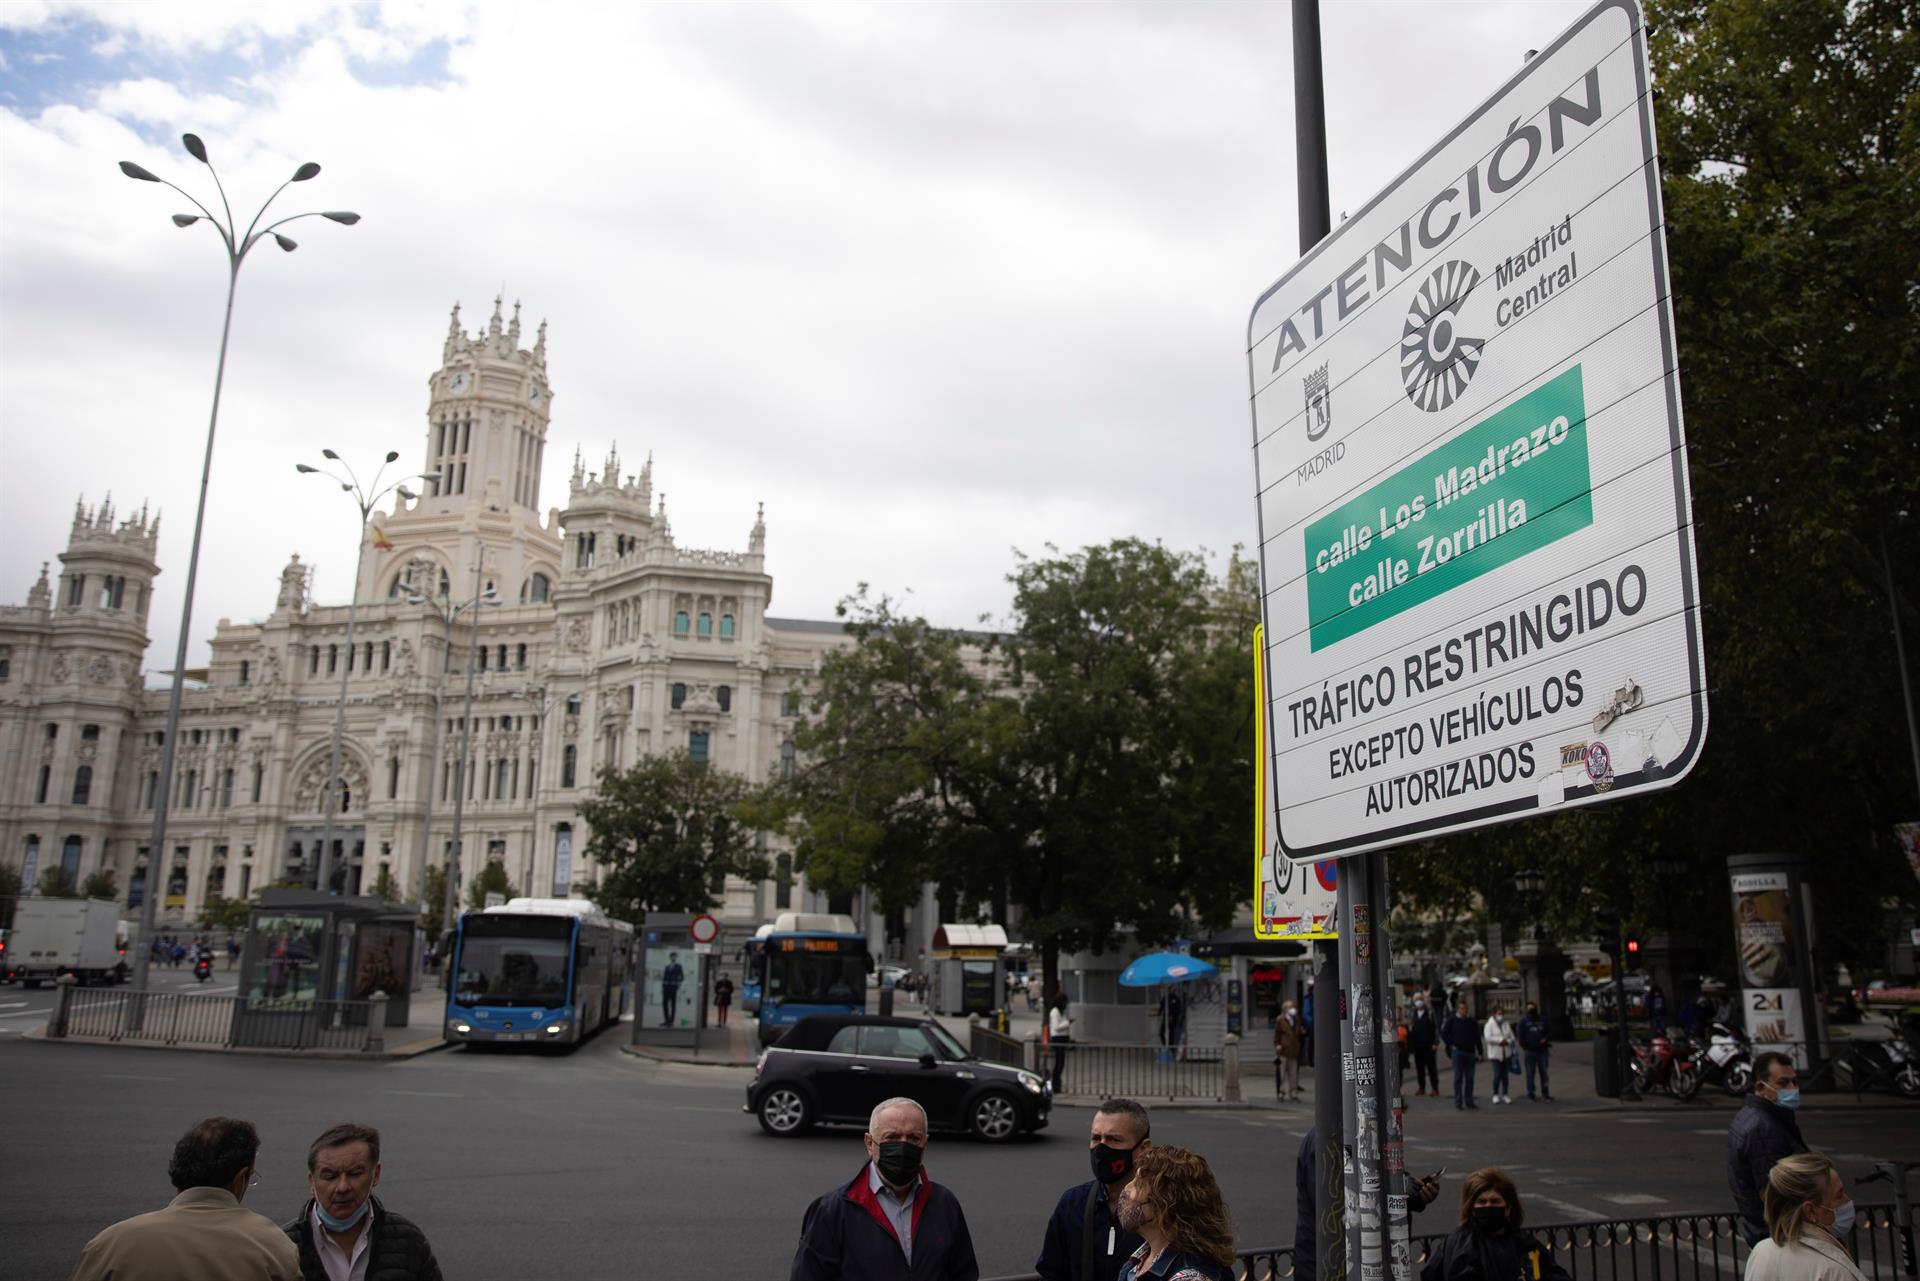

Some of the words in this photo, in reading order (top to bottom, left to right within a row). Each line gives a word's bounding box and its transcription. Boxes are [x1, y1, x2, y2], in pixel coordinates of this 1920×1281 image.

[1272, 67, 1603, 374] ATENCIÓN
[1495, 214, 1572, 291] Madrid
[1496, 252, 1577, 327] Central
[1297, 441, 1346, 487] MADRID
[1316, 522, 1372, 574] calle
[1380, 494, 1425, 541] Los
[1434, 415, 1569, 510] Madrazo
[1349, 557, 1410, 608] calle
[1416, 497, 1527, 572] Zorrilla
[1288, 666, 1396, 740] TRÁFICO
[1404, 564, 1647, 697] RESTRINGIDO
[1329, 722, 1424, 779] EXCEPTO
[1431, 669, 1584, 739] VEHÍCULOS
[1365, 741, 1536, 817] AUTORIZADOS
